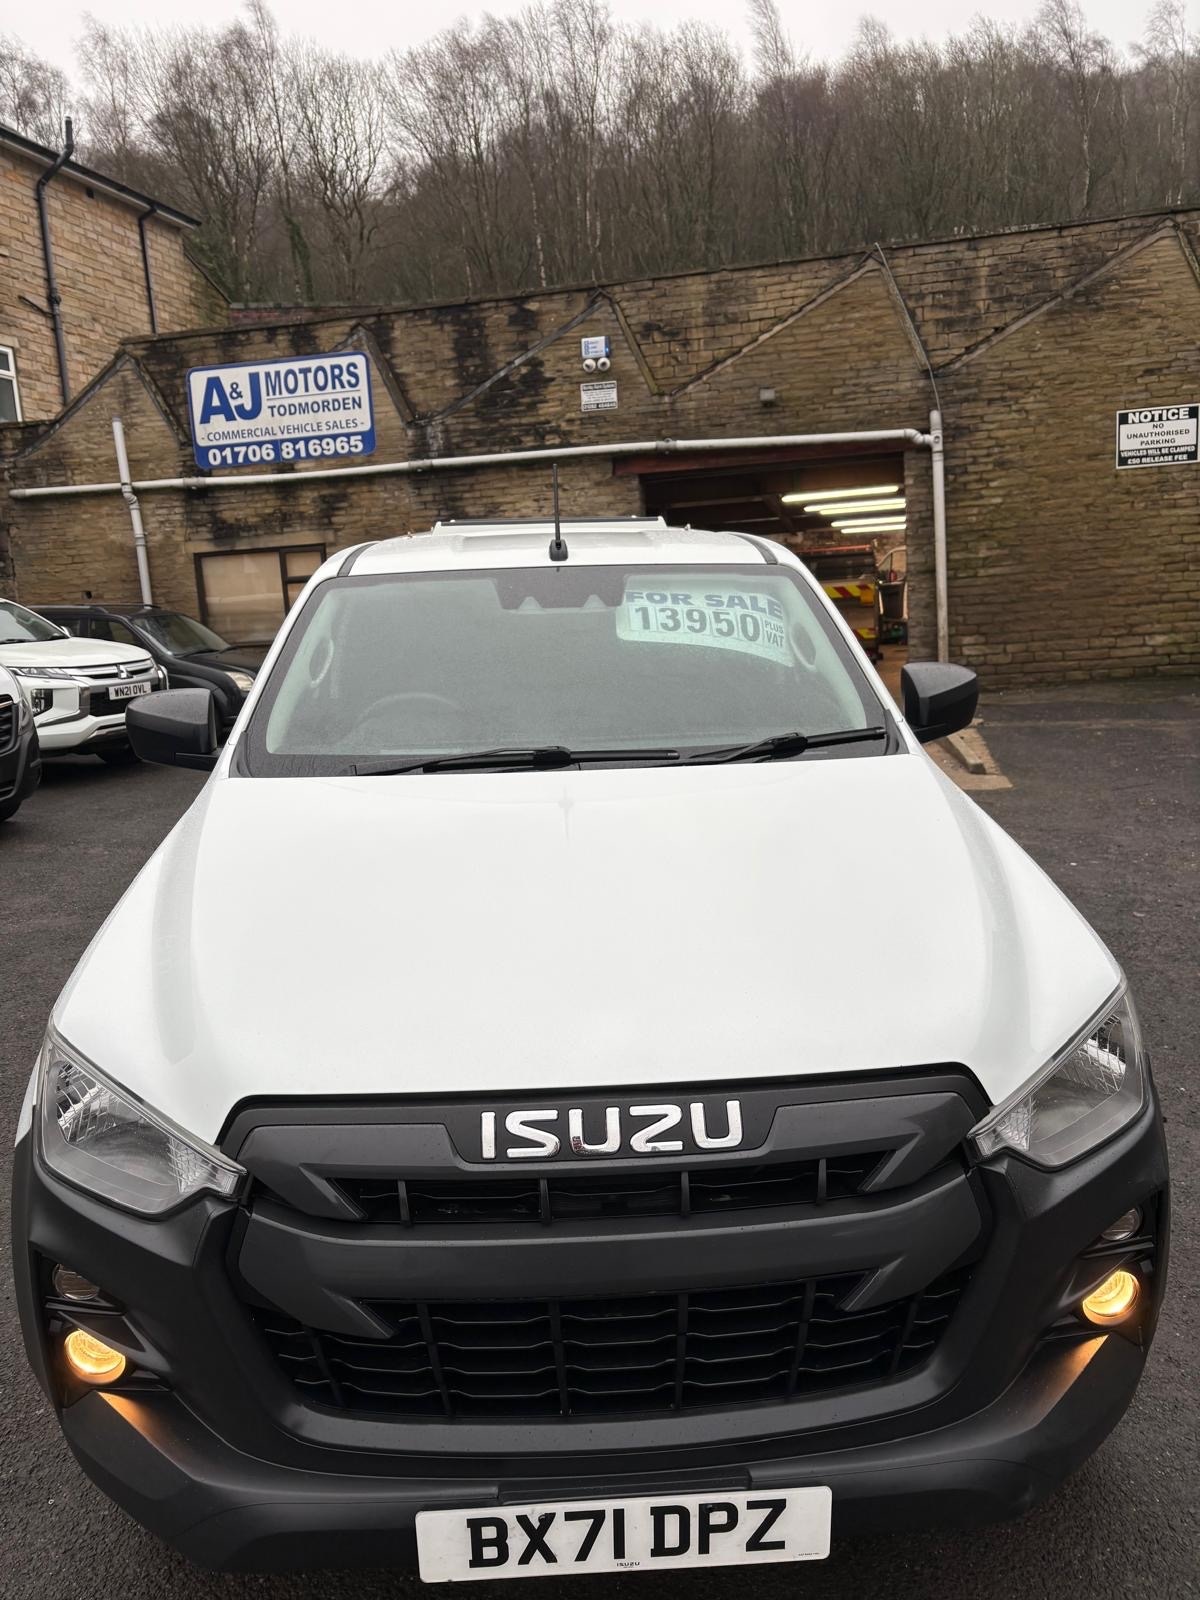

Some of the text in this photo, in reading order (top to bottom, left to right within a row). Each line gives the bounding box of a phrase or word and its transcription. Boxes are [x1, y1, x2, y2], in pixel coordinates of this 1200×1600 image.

[199, 361, 361, 425] A&J MOTORS
[267, 396, 362, 417] TODMORDEN
[1127, 407, 1190, 424] NOTICE
[207, 418, 358, 442] COMMERCIAL VEHICLE SALES
[1126, 429, 1190, 440] UNAUTHORISED
[208, 435, 364, 466] 01706 816965
[1120, 449, 1147, 457] VEHICLES
[1147, 448, 1161, 456] WILL
[1169, 445, 1196, 453] CLAMPED
[1140, 438, 1176, 447] PARKING
[1127, 457, 1140, 465] £50
[1141, 455, 1173, 463] RELEASE
[625, 591, 784, 621] FOR SALE
[634, 606, 761, 642] 13950
[764, 619, 785, 634] PLUS
[765, 631, 785, 648] VAT
[113, 684, 147, 697] WN21 OVL
[481, 1099, 744, 1160] ISUZU
[465, 1498, 787, 1569] BX71 DPZ
